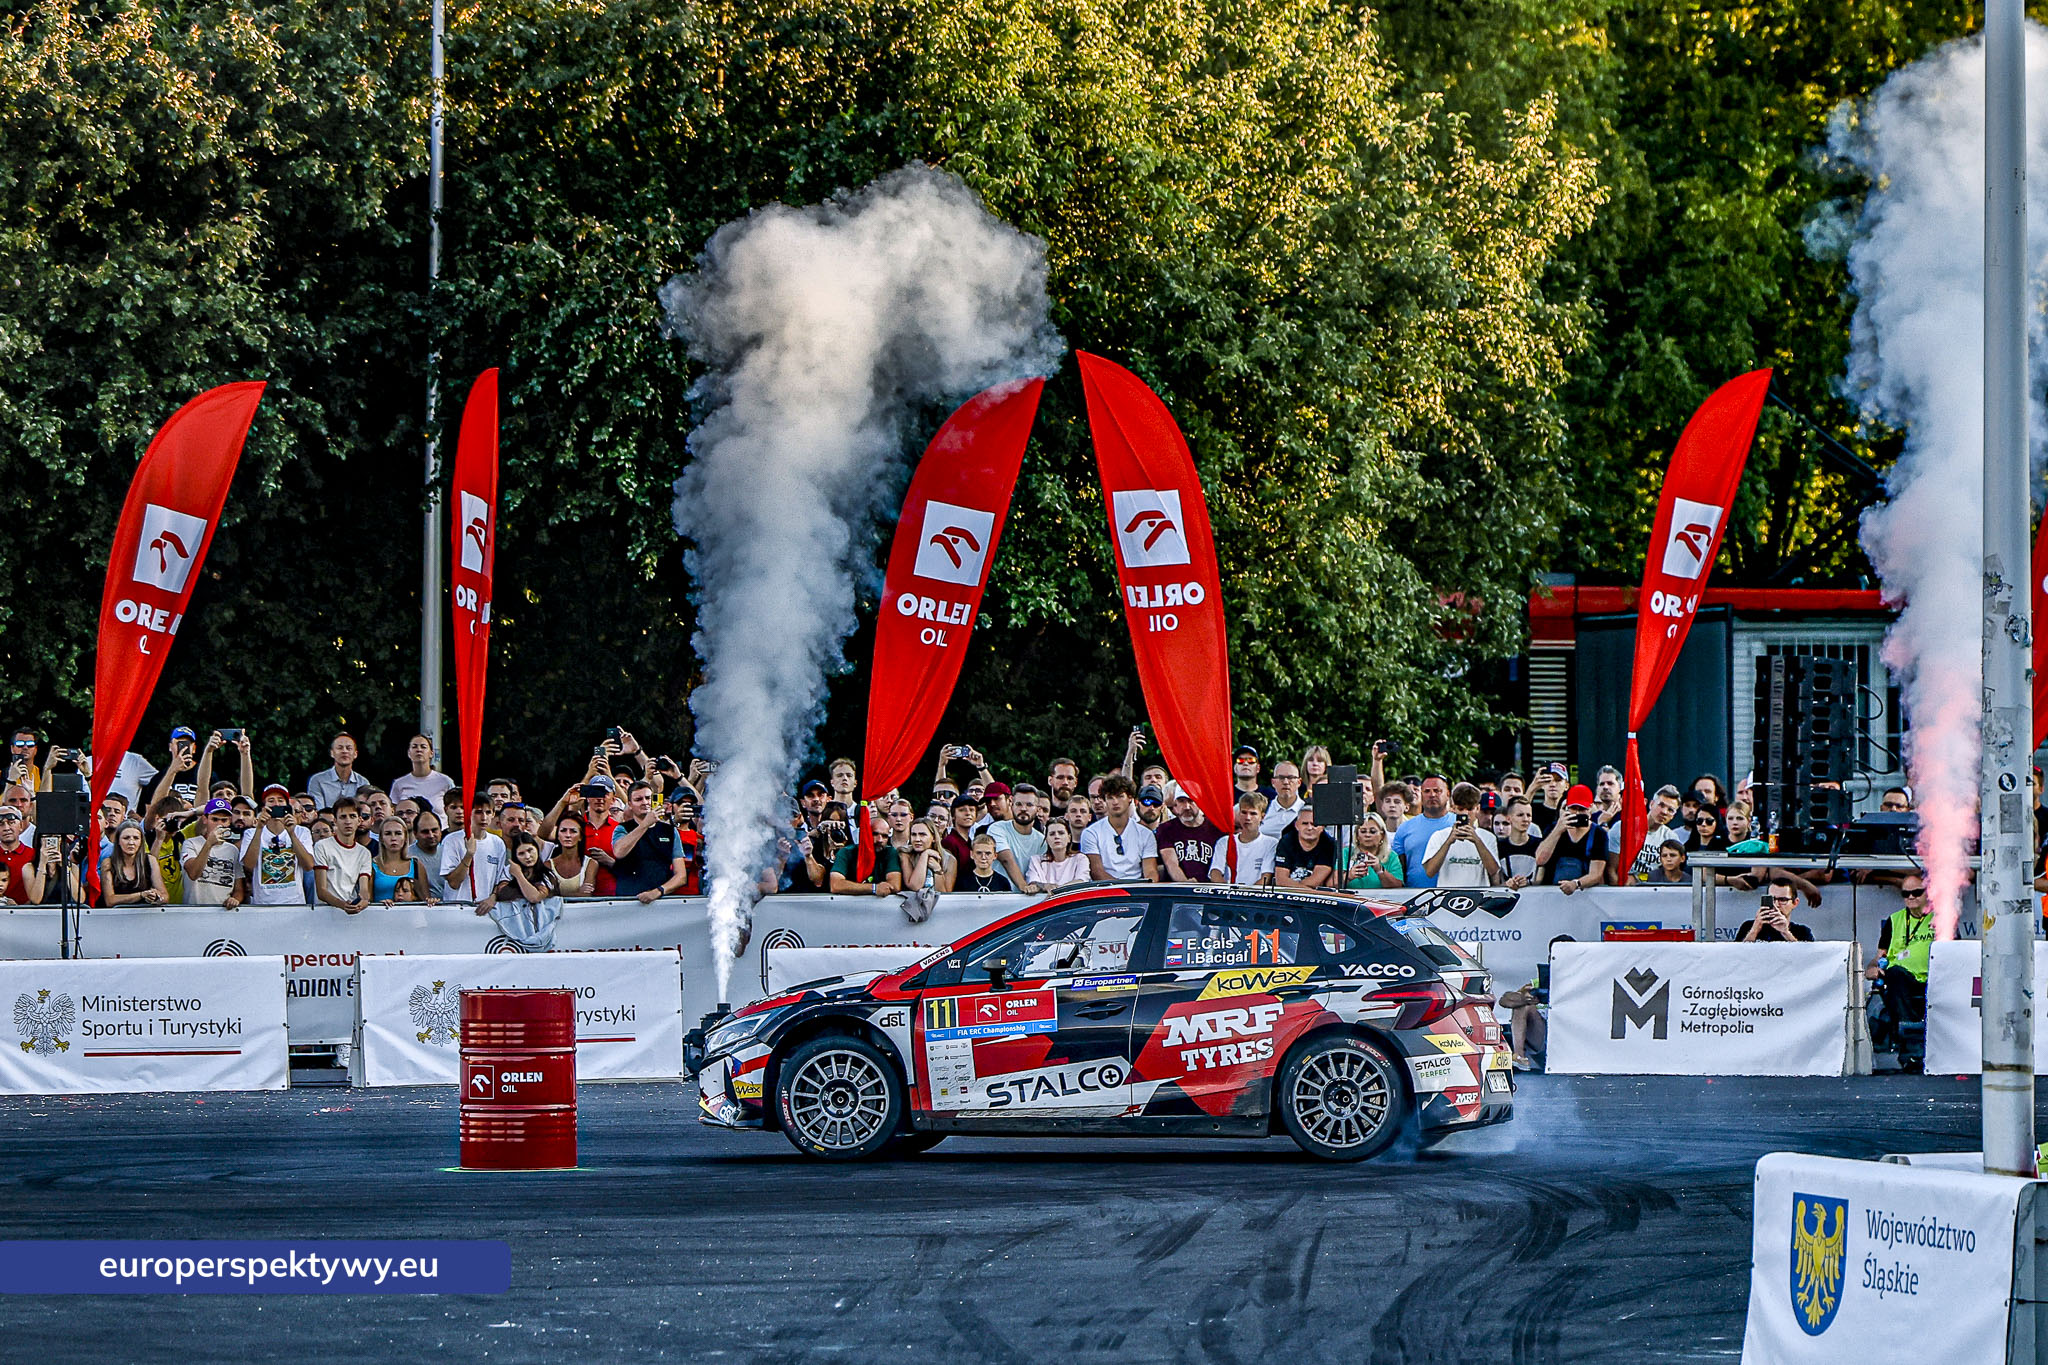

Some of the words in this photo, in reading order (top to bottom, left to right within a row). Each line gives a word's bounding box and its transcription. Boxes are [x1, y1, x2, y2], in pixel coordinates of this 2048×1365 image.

[920, 627, 948, 647] OIL
[1217, 889, 1275, 898] TRANSPORT
[1286, 895, 1338, 905] LOGISTICS
[1444, 926, 1522, 942] wództwo
[1244, 929, 1280, 965] 11
[922, 947, 950, 966] VALENS
[1338, 963, 1416, 978] YACCO
[287, 979, 341, 997] ADION
[1084, 978, 1134, 986] Europartner
[1682, 986, 1764, 1003] Górnośląsko
[82, 995, 202, 1012] Ministerstwo
[1005, 998, 1038, 1009] ORLEN
[576, 1004, 636, 1026] rystyki
[930, 999, 951, 1029] 11
[82, 1020, 143, 1039] Sportu
[148, 1019, 153, 1035] i
[158, 1017, 242, 1038] Turystyki
[970, 1027, 981, 1035] ERC
[983, 1024, 1026, 1034] Championship
[1162, 1002, 1285, 1047] MRF
[1680, 1020, 1755, 1036] Metropolia
[1180, 1037, 1275, 1071] TYRES
[1415, 1056, 1451, 1071] STALCO
[500, 1072, 543, 1083] ORLEN
[1420, 1068, 1451, 1078] PERFECT
[501, 1084, 518, 1093] OIL
[986, 1063, 1124, 1108] STALCO
[1455, 1092, 1479, 1104] MRF
[1866, 1208, 1977, 1254] Województwo
[1862, 1252, 1919, 1300] Śląskie
